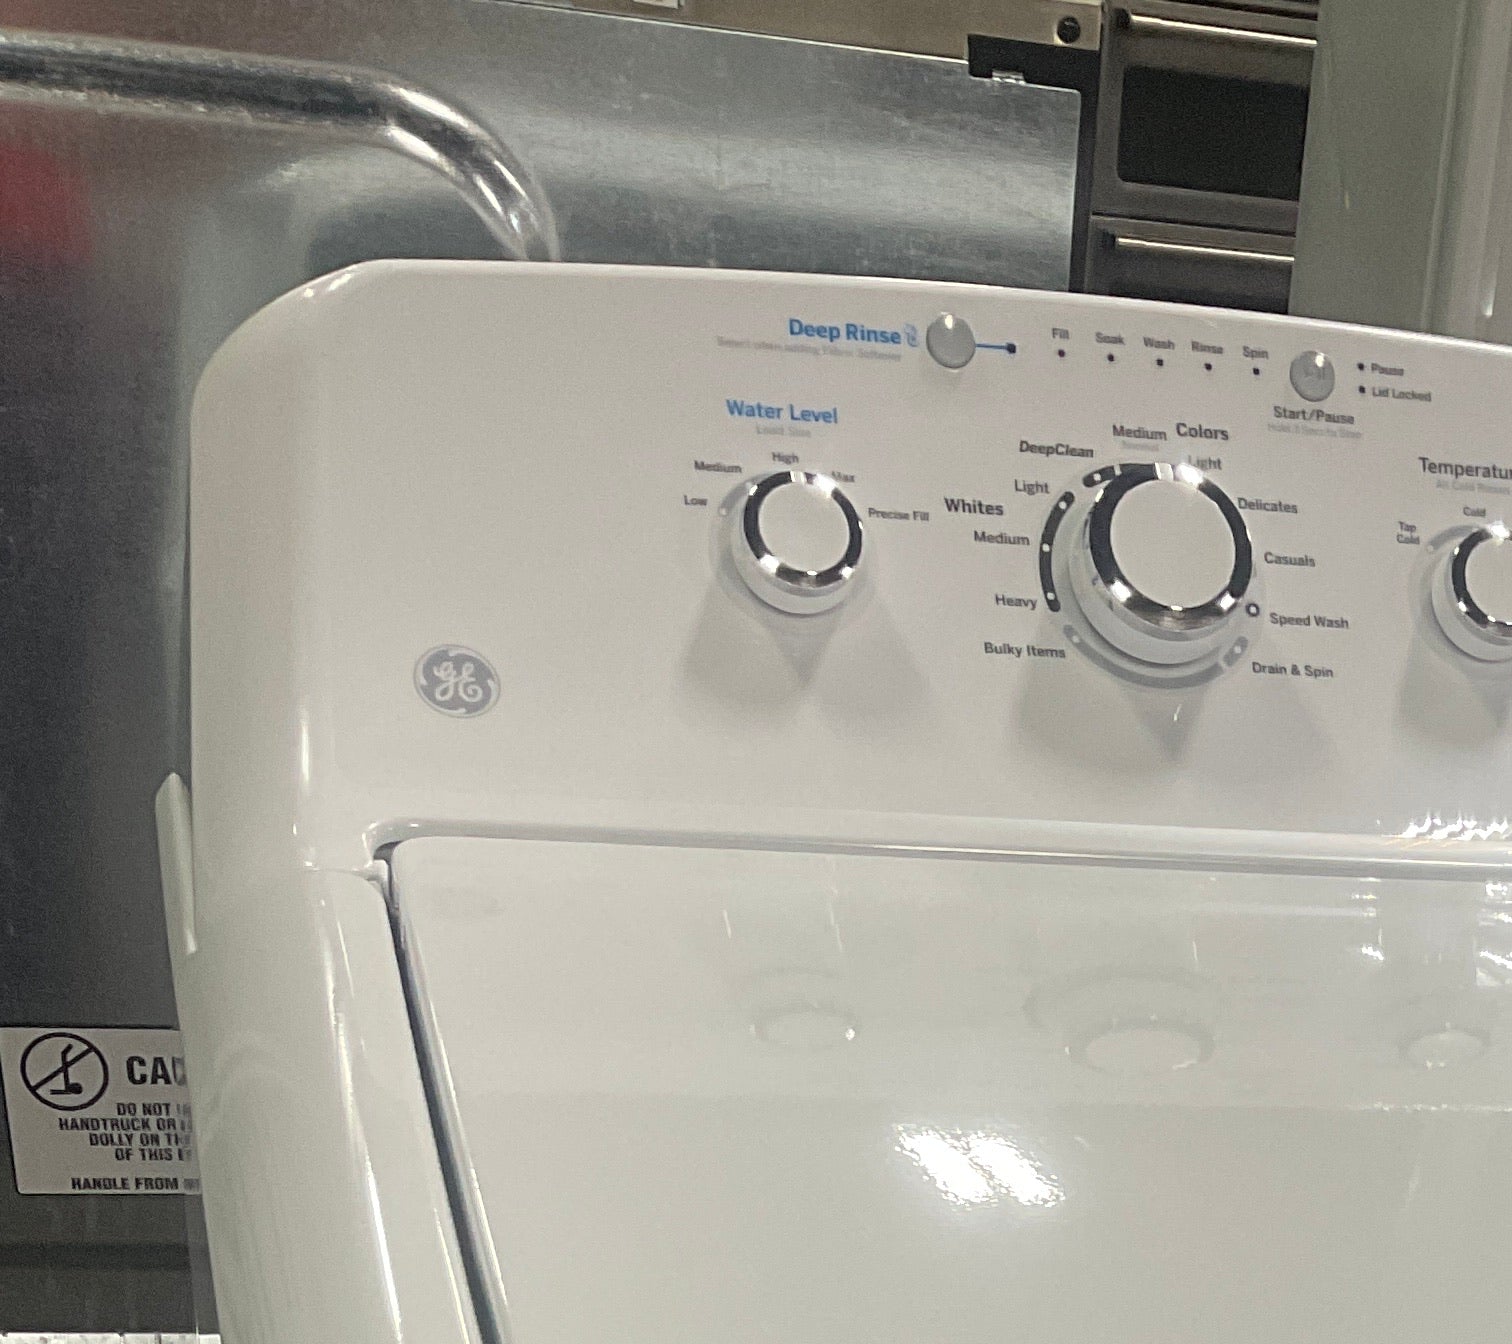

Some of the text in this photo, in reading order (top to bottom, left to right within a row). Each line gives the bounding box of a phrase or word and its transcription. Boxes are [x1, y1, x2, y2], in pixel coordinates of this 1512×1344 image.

[789, 318, 901, 345] Deep Rinse
[1052, 327, 1070, 340] Fill
[1243, 345, 1269, 360] Spin
[725, 399, 838, 424] Water Level
[1273, 406, 1355, 425] Start/Pause
[1112, 424, 1167, 441] Medium
[1176, 422, 1229, 441] Colors
[1019, 440, 1094, 458] DeepClean
[771, 451, 799, 465] High
[694, 460, 742, 474] Medium
[1014, 480, 1049, 495] Light
[684, 495, 708, 507] Low
[944, 497, 1004, 516] Whites
[1237, 497, 1299, 514] Delicates
[868, 507, 930, 522] Precise Fill
[1463, 506, 1487, 518] Cold
[974, 530, 1030, 546] Medium
[1264, 551, 1316, 567] Casuals
[995, 594, 1037, 610] Heavy
[1269, 612, 1349, 629] Speed Wash
[984, 641, 1066, 659] Bulky Items
[1252, 661, 1334, 679] Drain & Spin
[116, 1102, 137, 1116] DO
[142, 1102, 171, 1116] NOT
[58, 1117, 150, 1131] HANDTRUCK
[156, 1117, 177, 1131] OR
[89, 1133, 134, 1146] DOLLY
[139, 1133, 160, 1146] ON
[115, 1148, 134, 1161] OF
[139, 1148, 173, 1161] THIS
[71, 1177, 130, 1190] HANDLE
[135, 1177, 179, 1190] FROM
